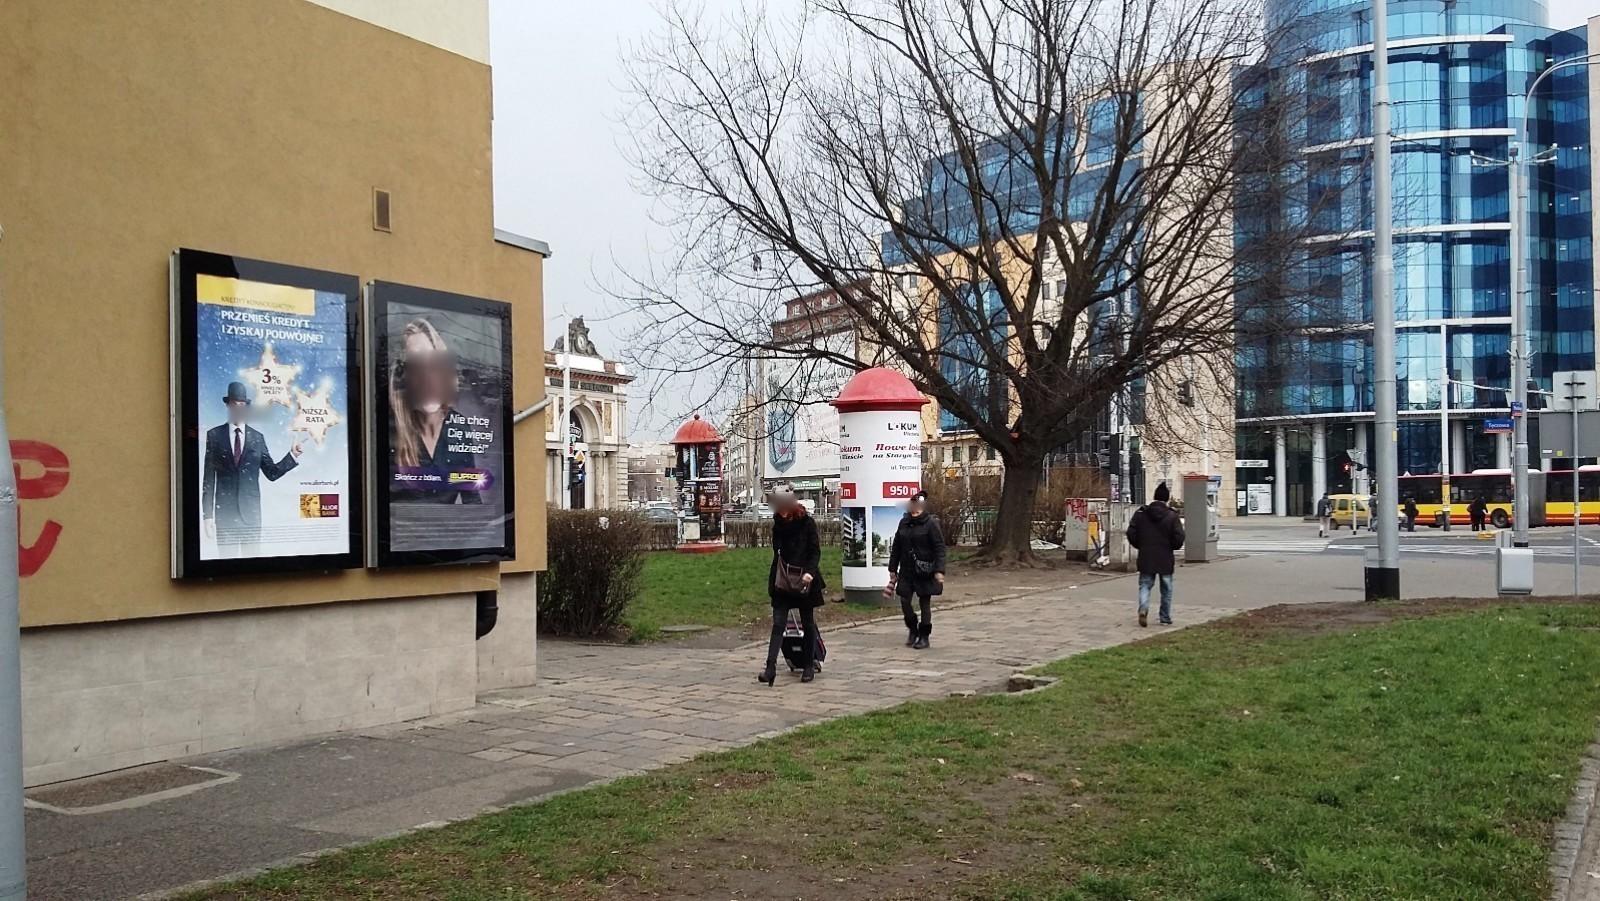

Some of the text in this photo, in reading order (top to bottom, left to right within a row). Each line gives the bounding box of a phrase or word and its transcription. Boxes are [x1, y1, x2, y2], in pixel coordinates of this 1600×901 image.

[221, 310, 311, 328] PRZENIEŚ KREDYT
[221, 324, 226, 333] I
[226, 325, 264, 339] ZYSKAJ
[262, 368, 281, 385] 3%
[467, 416, 490, 428] chcę
[447, 428, 494, 442] Cię więcej
[875, 443, 907, 451] Nowe
[394, 473, 417, 481] Skończ
[889, 485, 919, 496] 950 m
